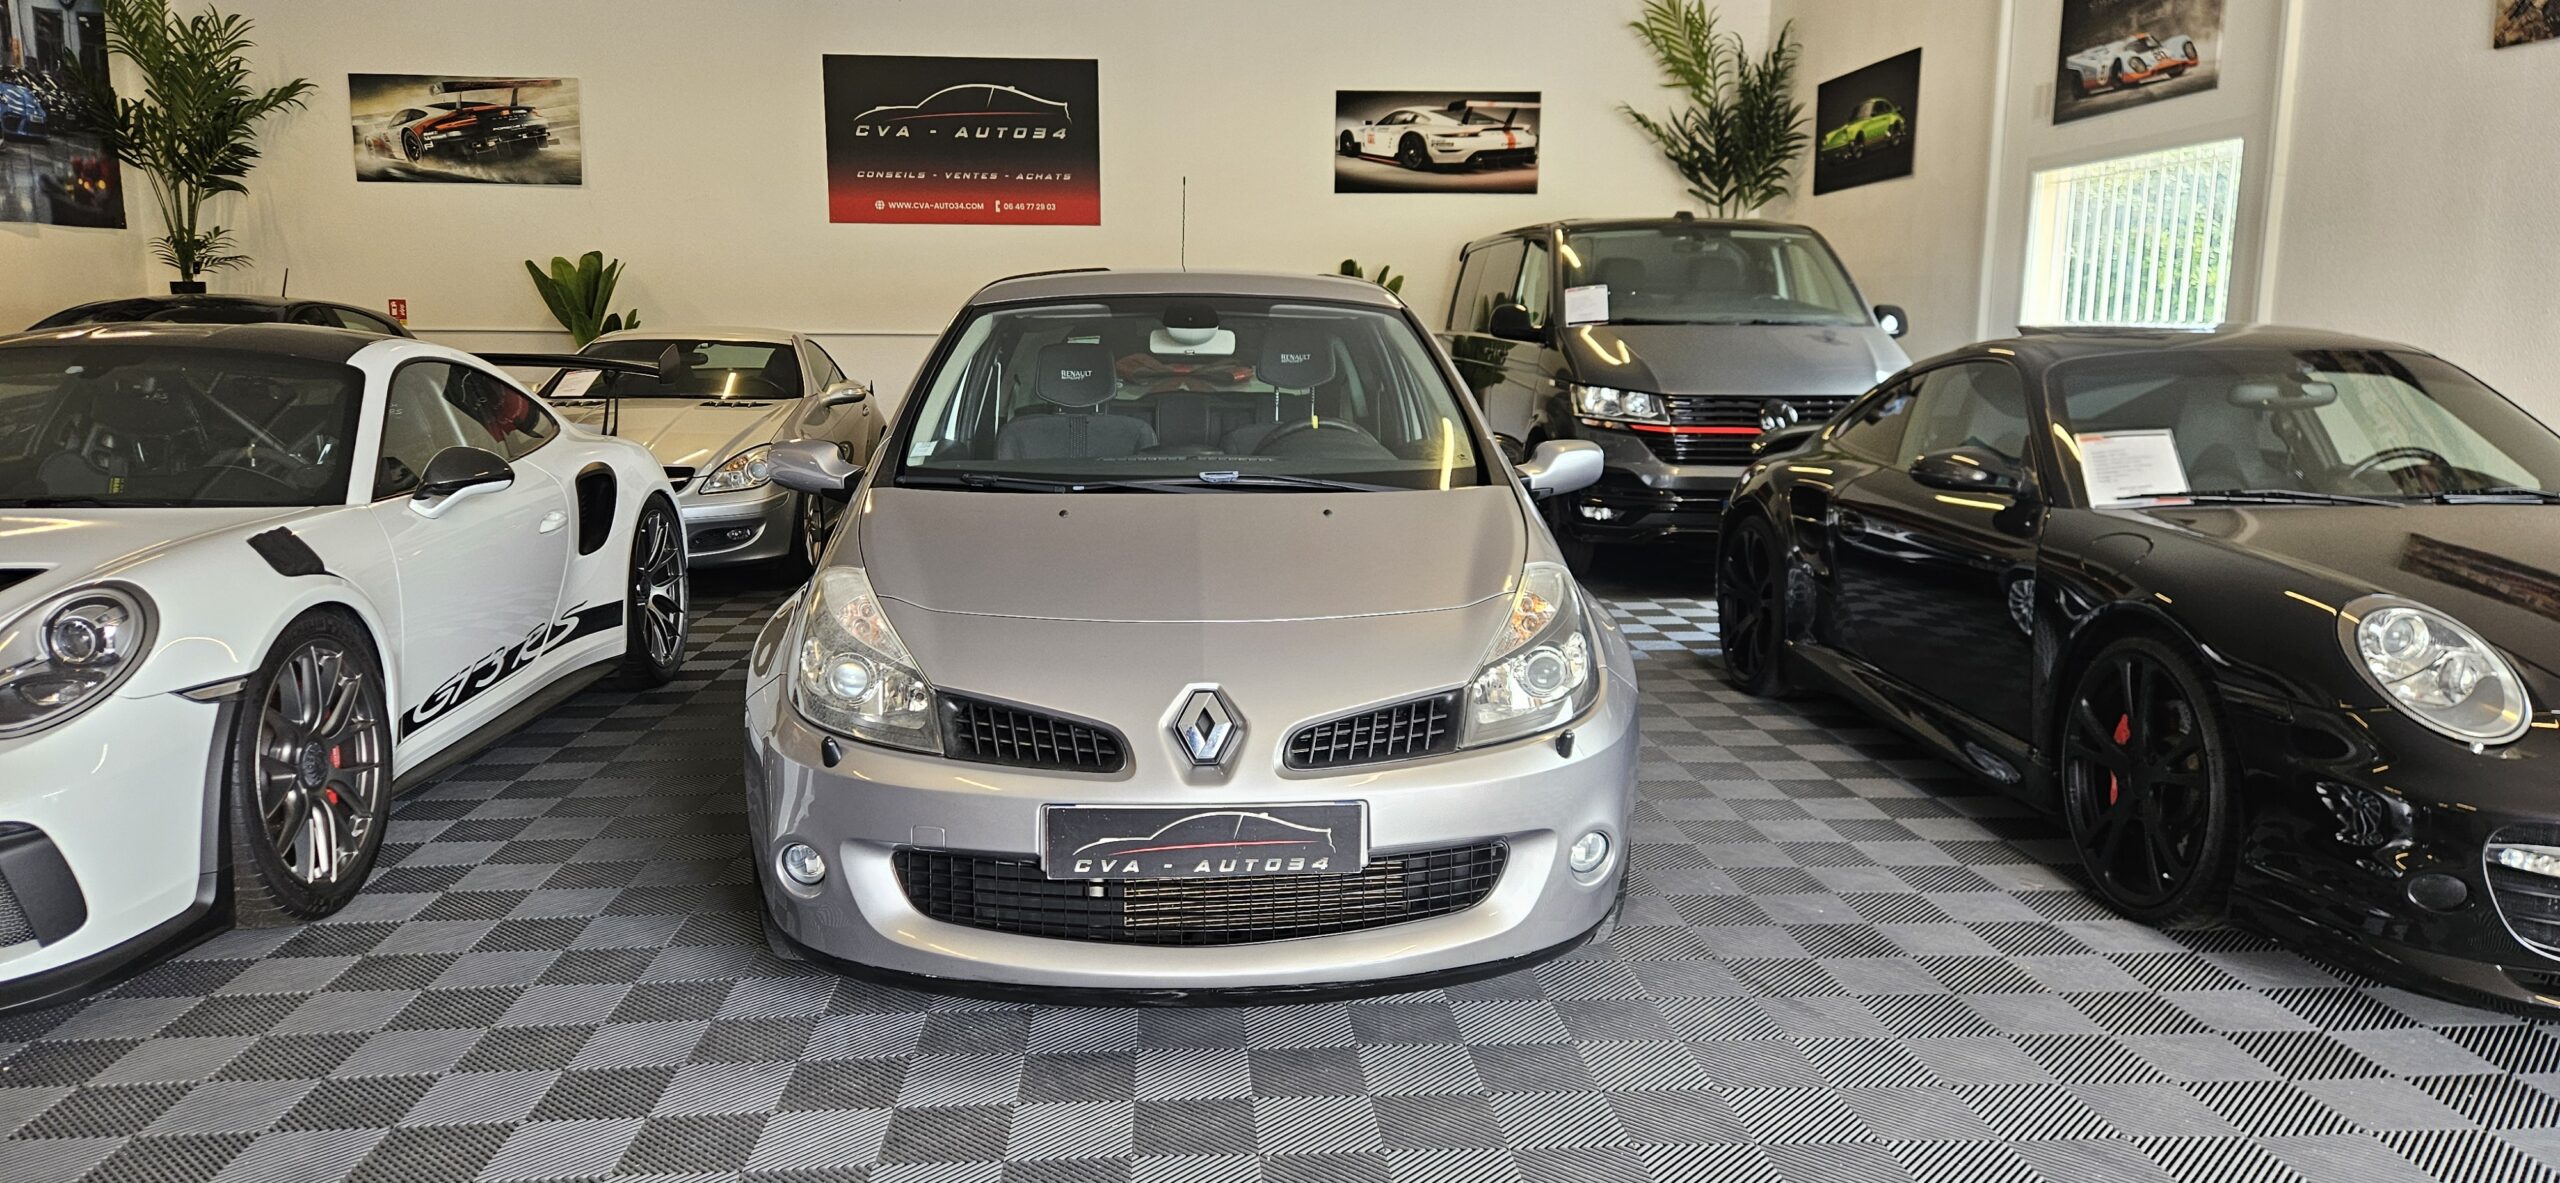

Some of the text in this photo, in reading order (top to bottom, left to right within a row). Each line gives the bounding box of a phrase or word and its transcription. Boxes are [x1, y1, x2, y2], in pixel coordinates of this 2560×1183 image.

[855, 125, 910, 138] CVA
[954, 126, 1067, 140] AUTO34
[856, 170, 926, 179] CONSEILS
[944, 172, 998, 180] VENTES
[1015, 172, 1072, 181] ACHATS
[888, 201, 985, 210] WWW.CVA-AUTO34.COM
[1003, 202, 1014, 211] 06
[1026, 203, 1036, 211] 77
[1046, 203, 1057, 211] 03
[1061, 369, 1093, 377] RENAULT
[412, 600, 588, 723] GT3 RS
[1074, 858, 1141, 873] CVA
[1193, 857, 1330, 873] AUTO34
